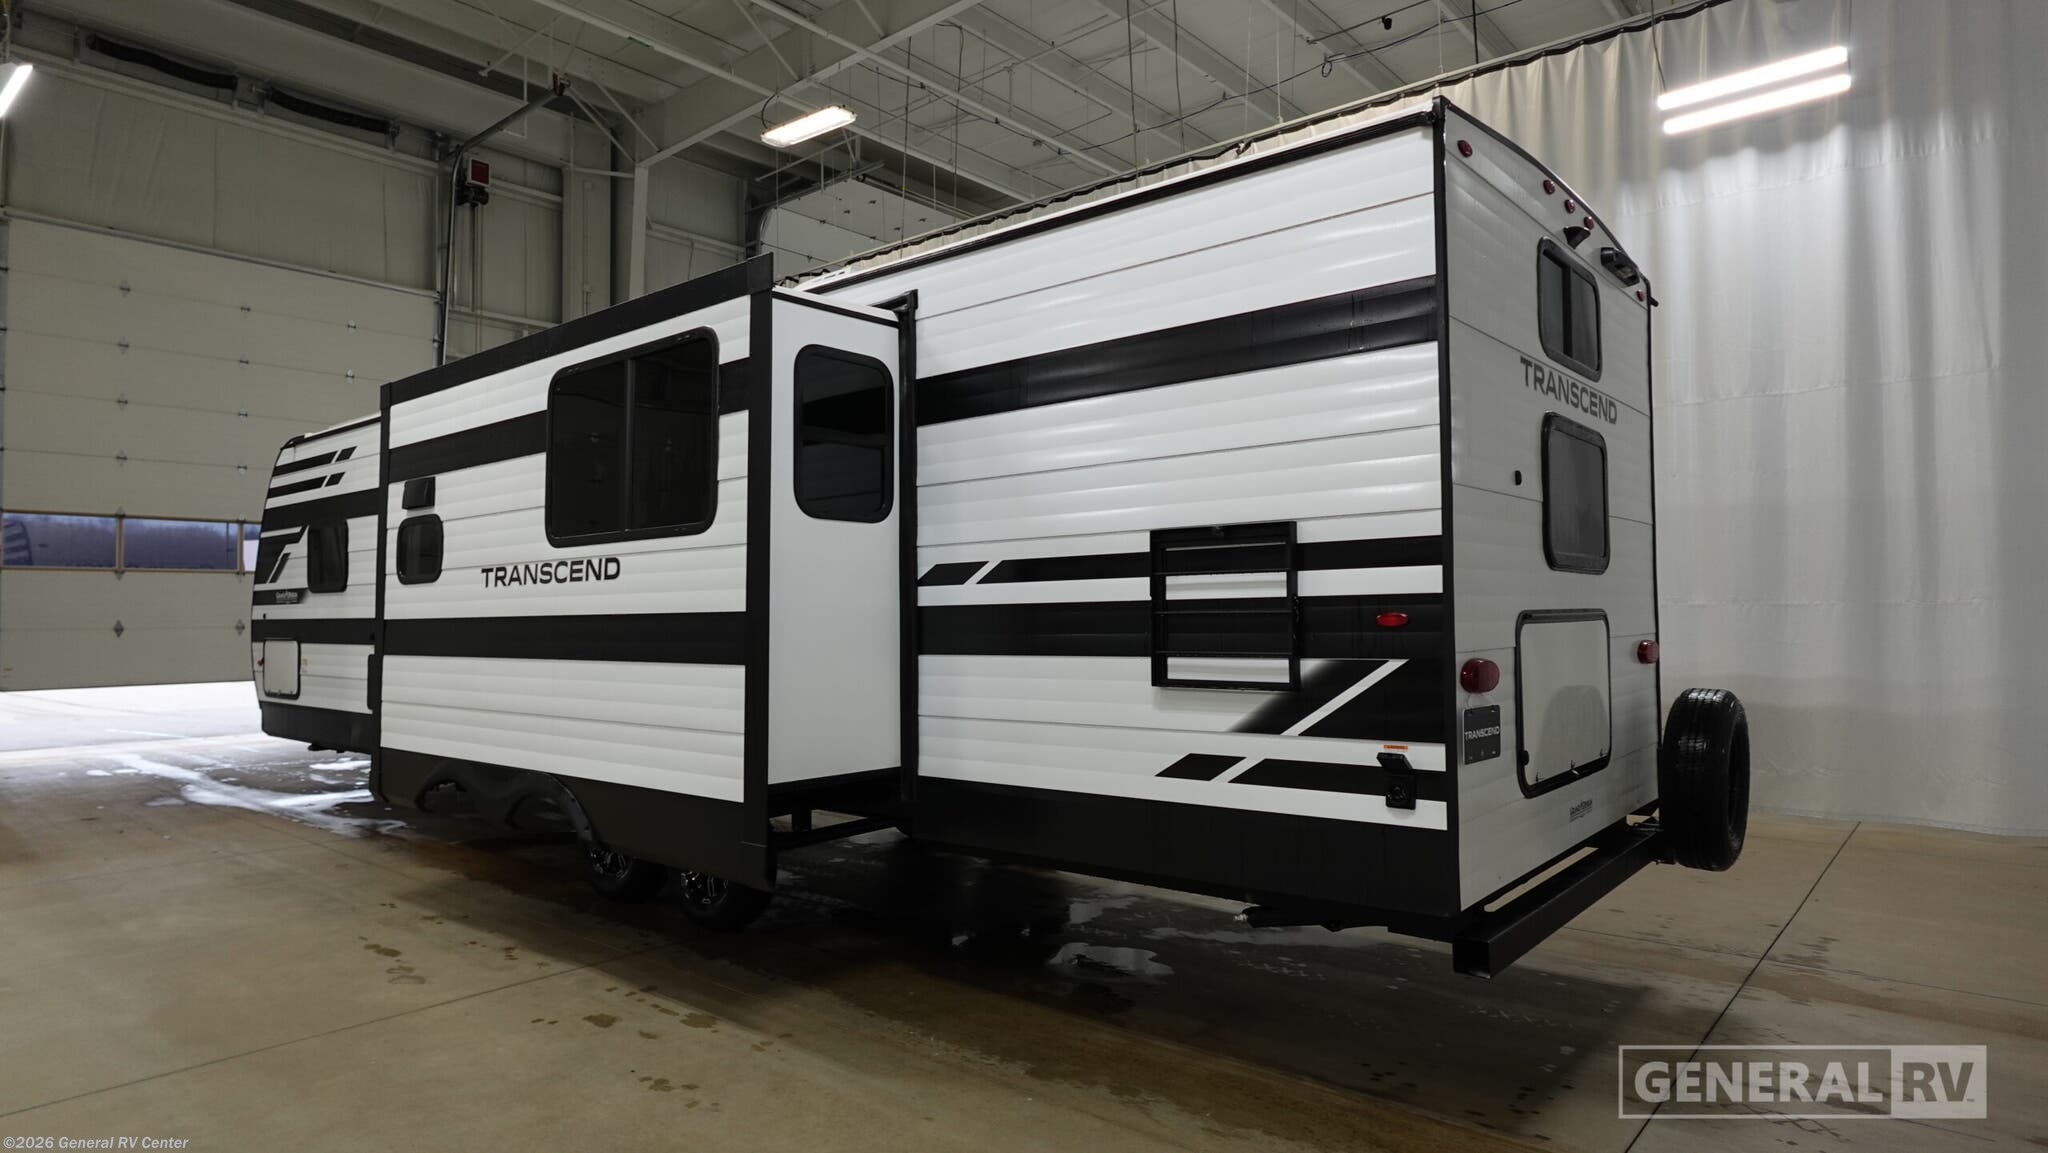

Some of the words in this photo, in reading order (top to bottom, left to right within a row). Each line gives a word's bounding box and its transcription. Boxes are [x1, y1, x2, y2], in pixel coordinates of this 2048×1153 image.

[1520, 356, 1617, 425] TRANSCEND
[481, 557, 621, 588] TRANSCEND
[1464, 726, 1500, 741] TRANSCEND
